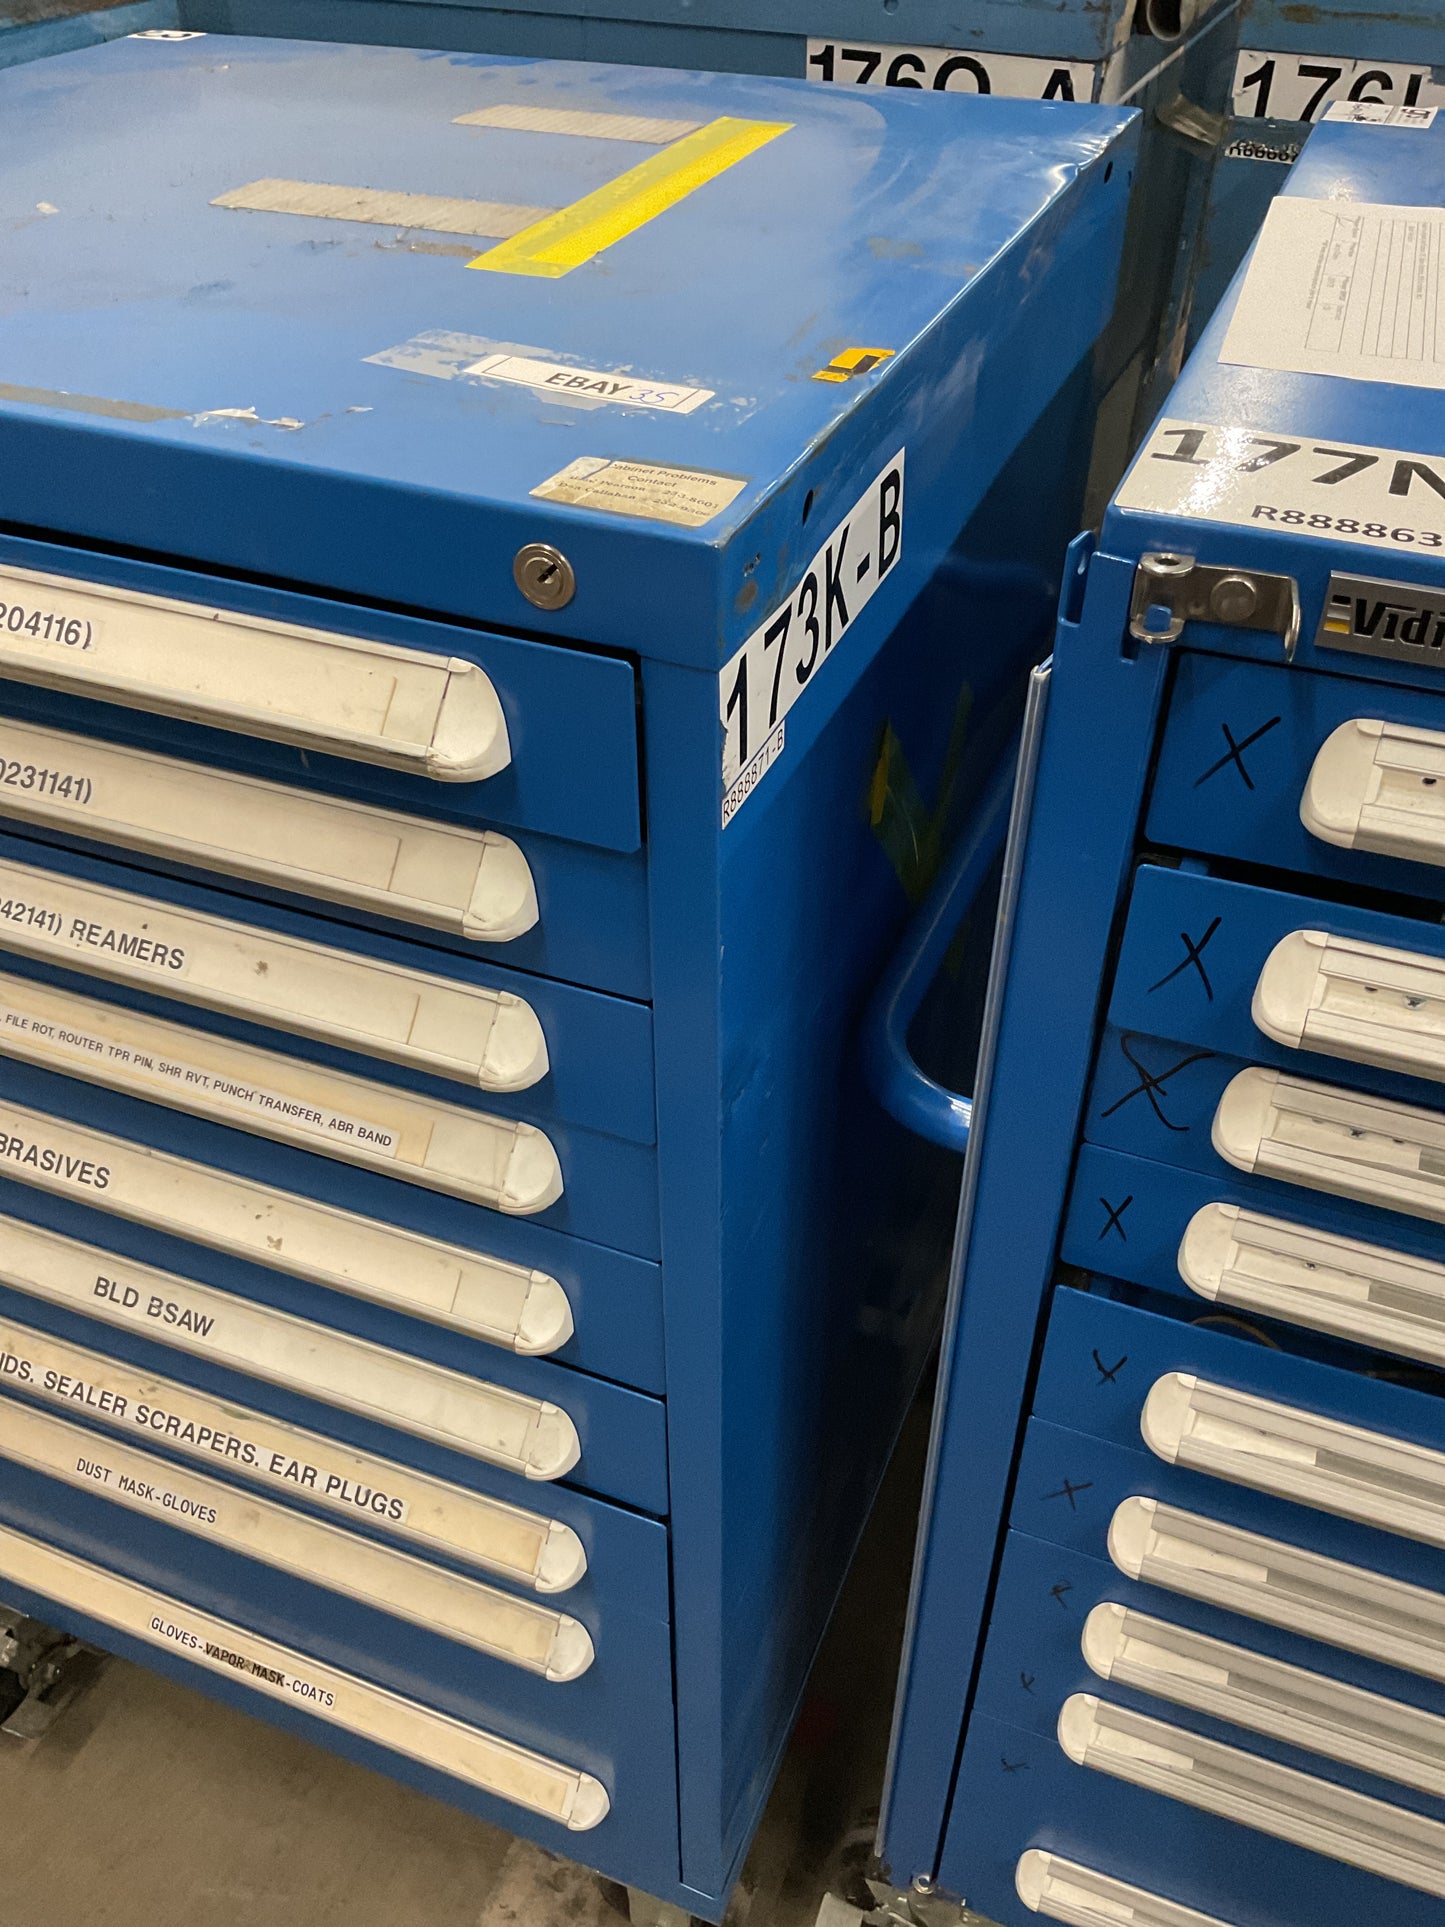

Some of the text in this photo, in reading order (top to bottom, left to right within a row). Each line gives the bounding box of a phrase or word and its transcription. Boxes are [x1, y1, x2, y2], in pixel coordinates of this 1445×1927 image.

[544, 372, 633, 395] EBAY
[585, 487, 636, 500] Callahan
[600, 480, 645, 492] Pearson
[627, 475, 677, 487] Contact
[658, 469, 717, 486] Problems
[1251, 504, 1443, 547] R888863
[727, 469, 901, 766] 173K-B
[723, 728, 783, 819] R888871-B
[0, 898, 185, 970] 42141) REAMERS
[5, 1014, 28, 1029] FILE
[32, 1023, 55, 1039] ROT,
[58, 1030, 104, 1053] ROUTER
[108, 1046, 130, 1061] TPR
[133, 1054, 154, 1071] PIN,
[158, 1062, 182, 1077] SHR
[213, 1079, 254, 1102] PUNCH
[258, 1093, 324, 1126] TRANSFER,
[328, 1118, 354, 1135] ABR
[357, 1126, 393, 1148] BAND
[93, 1276, 215, 1337] BLD BSAW
[44, 1370, 128, 1417] SEALER
[269, 1453, 318, 1487] EAR
[325, 1474, 404, 1520] PLUGS
[76, 1458, 217, 1524] DUST MASK-GLOVES
[151, 1617, 335, 1706] GLOVES-VAPOR MASK-COATS
